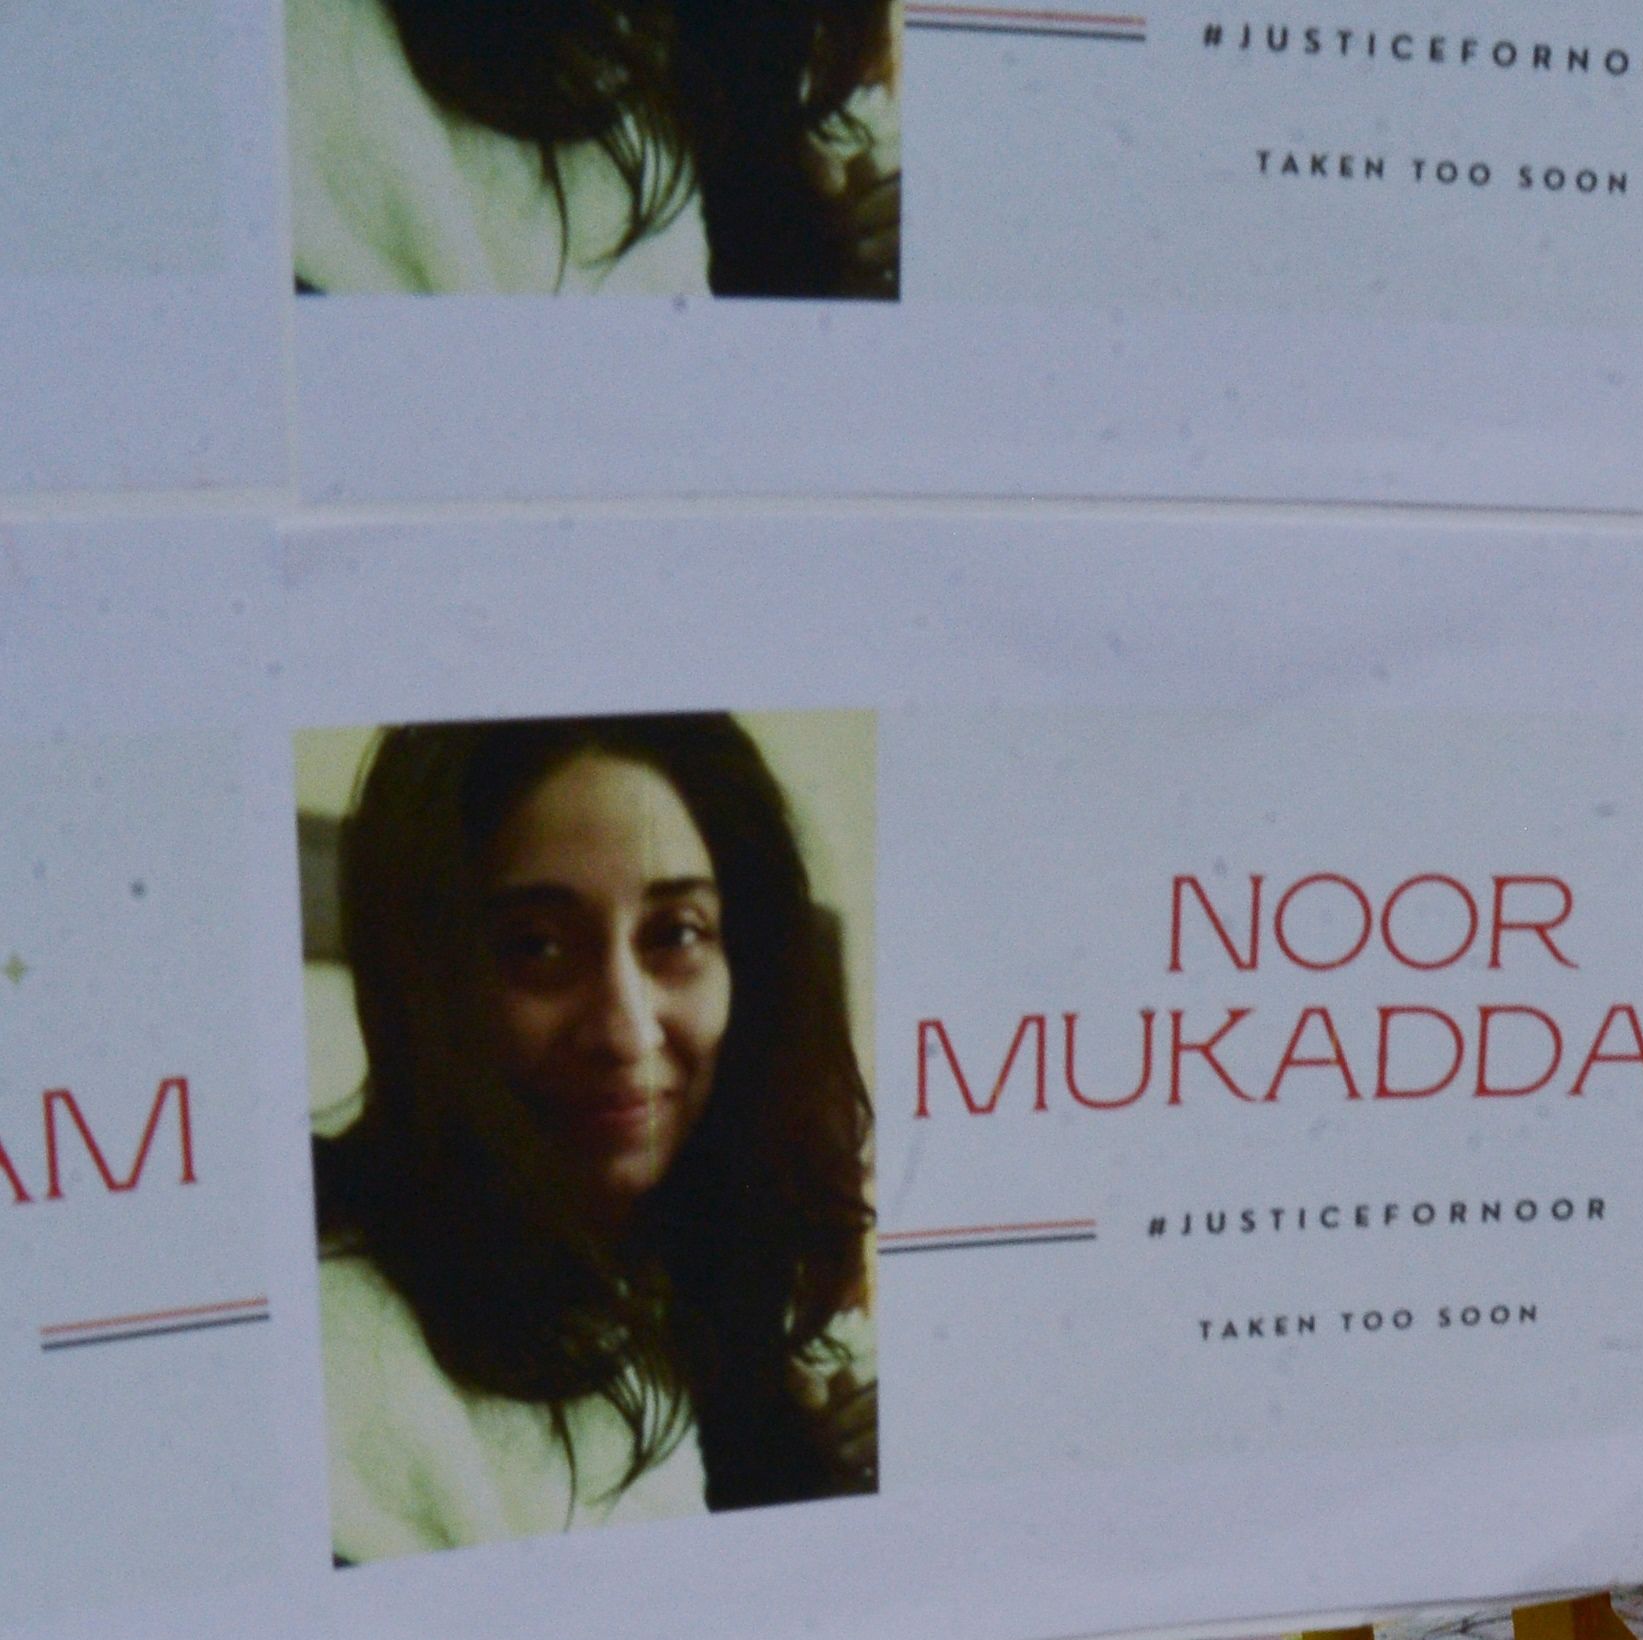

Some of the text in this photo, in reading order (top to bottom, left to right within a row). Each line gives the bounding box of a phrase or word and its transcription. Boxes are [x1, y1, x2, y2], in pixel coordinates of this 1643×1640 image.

[1256, 148, 1628, 194] TAKEN TOO SOON
[1166, 871, 1579, 974] NOOR
[1147, 1197, 1607, 1238] #JUSTICEFORNOOR
[1198, 1303, 1541, 1342] TAKEN TOO SOON
